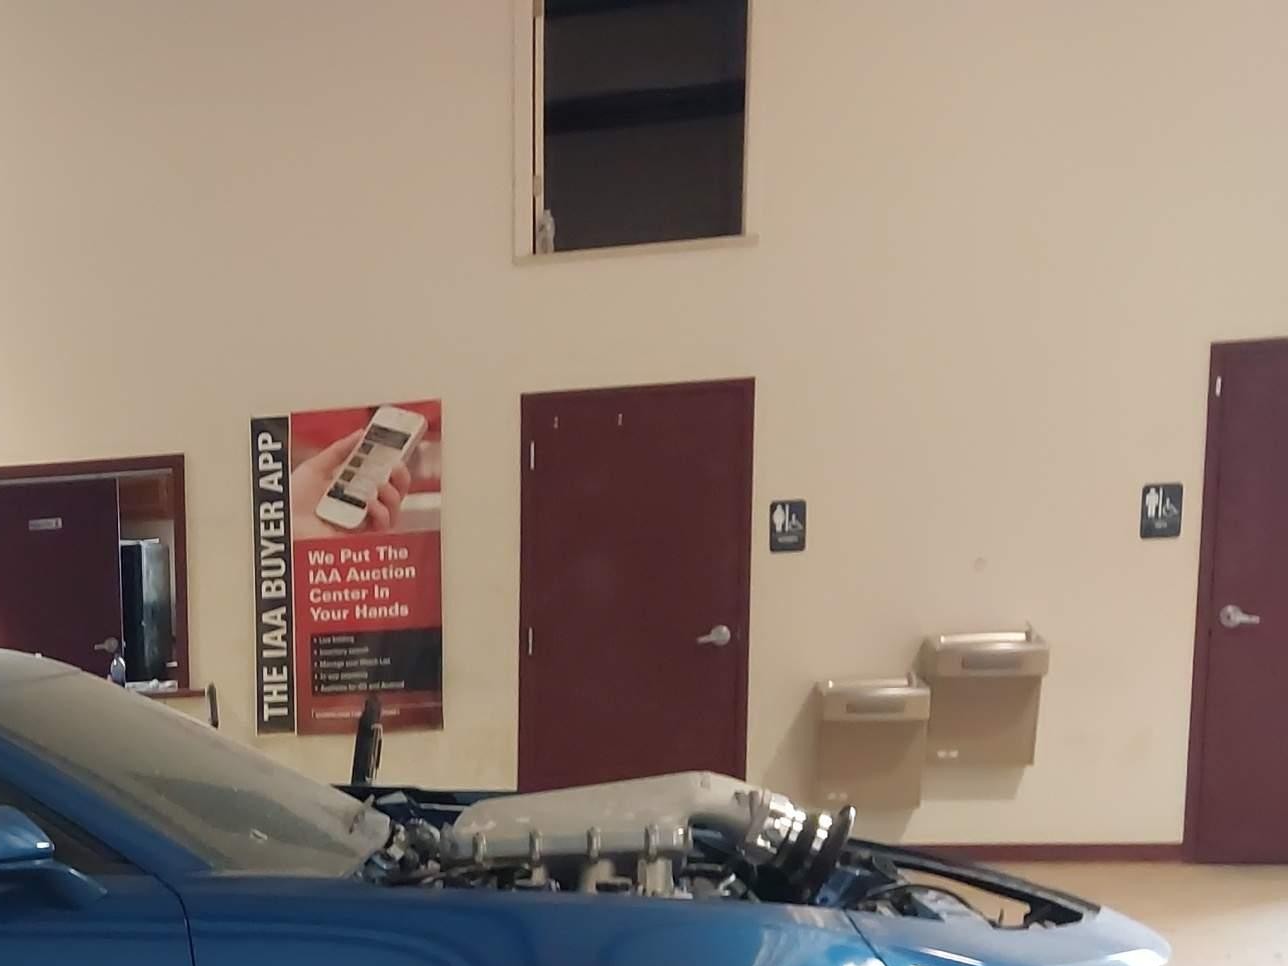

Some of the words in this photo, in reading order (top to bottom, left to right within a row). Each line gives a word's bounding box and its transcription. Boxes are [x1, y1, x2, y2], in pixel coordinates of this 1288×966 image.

[257, 431, 284, 494] APP
[260, 500, 286, 599] BUYER
[308, 549, 335, 566] We
[340, 547, 371, 564] Put
[375, 544, 409, 562] The
[309, 567, 342, 585] IAA
[345, 564, 416, 583] Auction
[309, 586, 369, 604] Center
[374, 583, 390, 600] In
[309, 606, 350, 622] Your
[355, 601, 409, 620] Hands
[261, 605, 288, 658] IAA
[263, 665, 289, 722] THE
